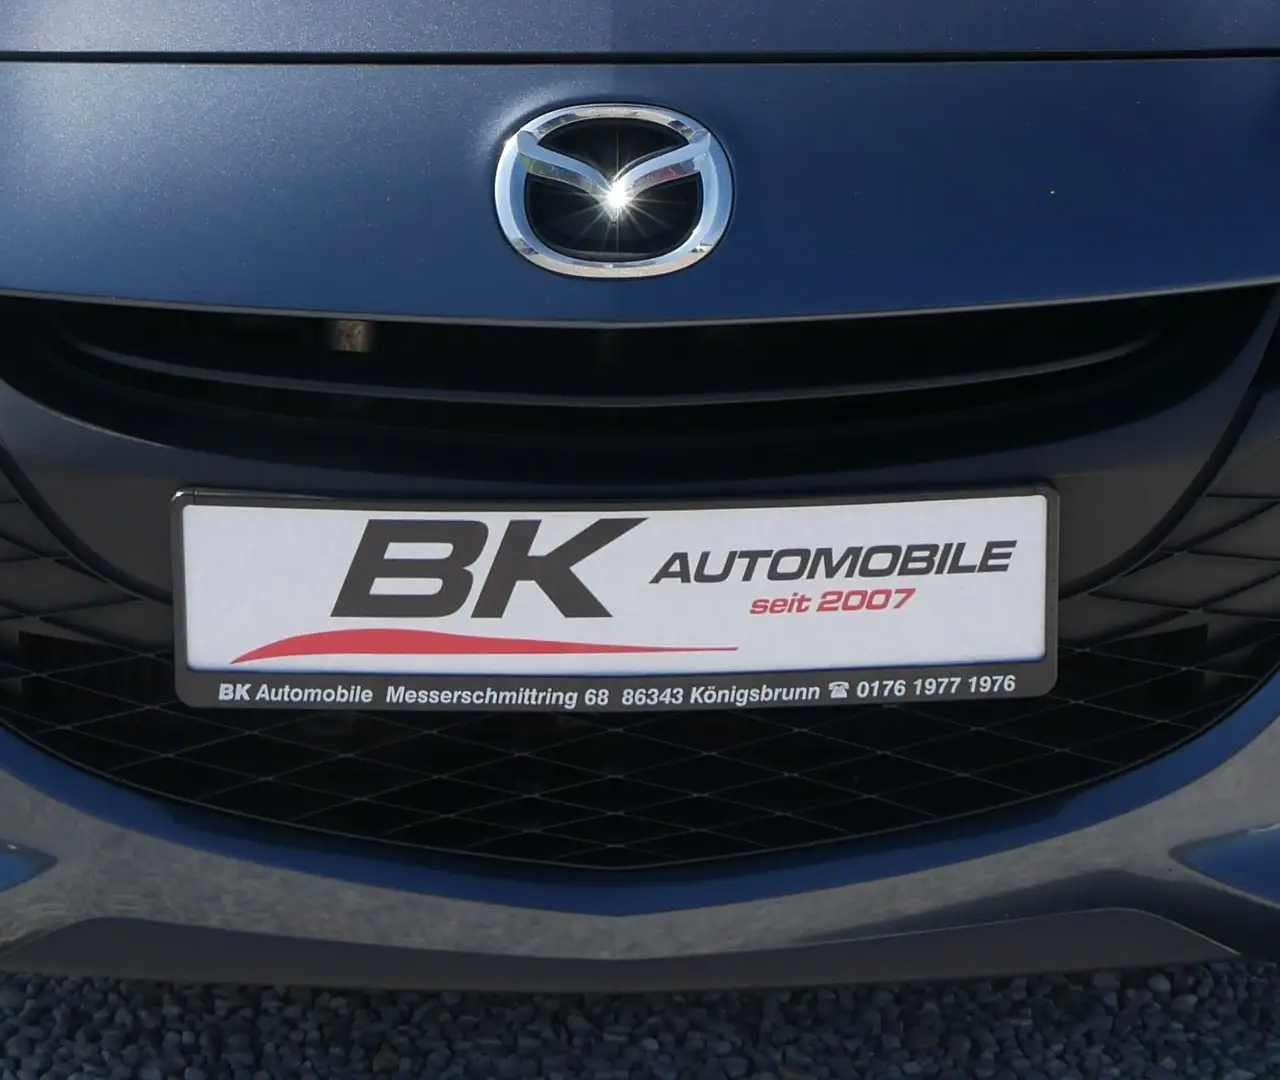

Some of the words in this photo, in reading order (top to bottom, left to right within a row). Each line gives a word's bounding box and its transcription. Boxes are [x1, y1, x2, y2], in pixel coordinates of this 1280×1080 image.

[330, 518, 650, 619] BK
[648, 540, 1018, 585] AUTOMOBILE
[749, 591, 811, 616] seit
[818, 588, 917, 613] 2007
[218, 683, 251, 701] BK
[255, 683, 374, 703] Automobile
[386, 685, 579, 710] Messerschmittring
[584, 688, 610, 706] 68
[622, 687, 684, 706] 86343
[689, 684, 821, 707] Königsbrunn
[856, 679, 907, 698] 0176
[913, 677, 962, 696] 1977
[968, 674, 1016, 693] 1976
